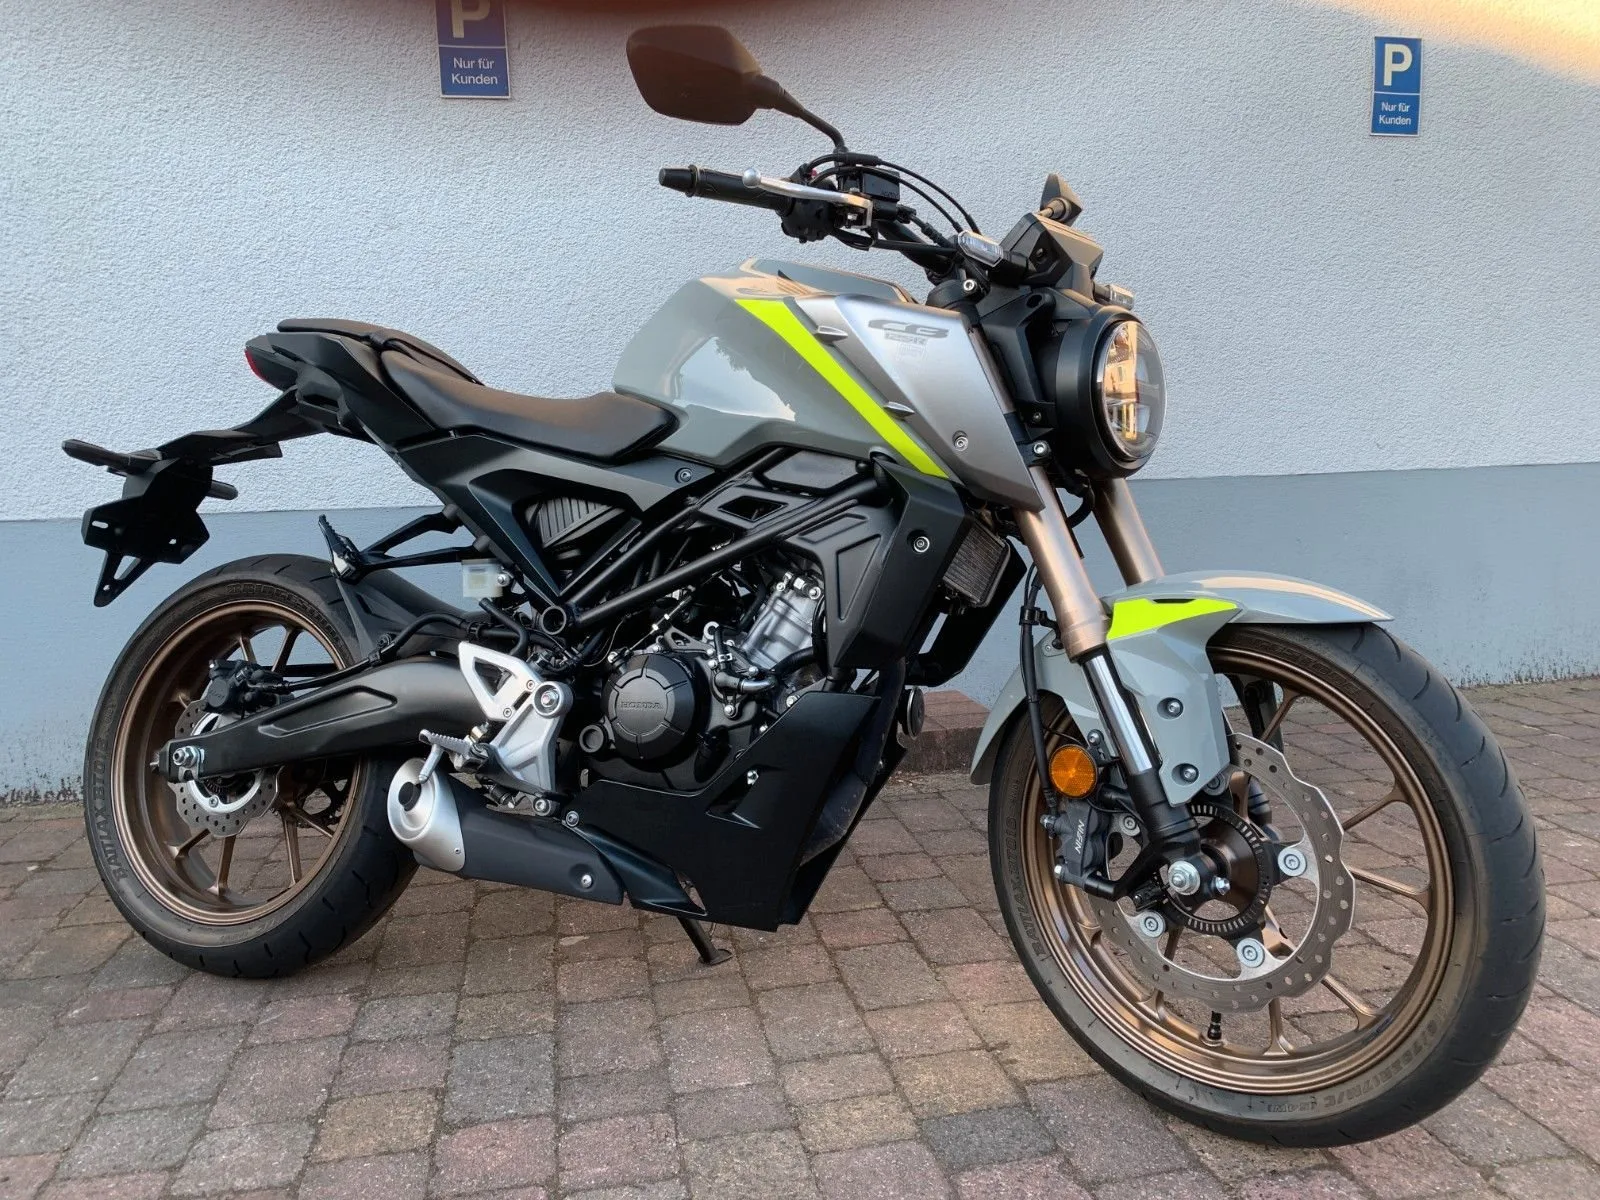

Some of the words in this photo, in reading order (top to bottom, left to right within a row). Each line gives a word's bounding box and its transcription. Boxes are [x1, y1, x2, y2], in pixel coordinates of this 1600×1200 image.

[451, 0, 491, 38] P
[453, 57, 475, 69] Nur
[477, 57, 495, 70] für
[1383, 43, 1413, 87] P
[451, 73, 498, 85] Kunden
[1381, 102, 1396, 112] Nur
[1398, 102, 1411, 113] für
[1379, 114, 1412, 125] Kunden
[868, 319, 950, 338] CB
[620, 701, 663, 710] HONDA
